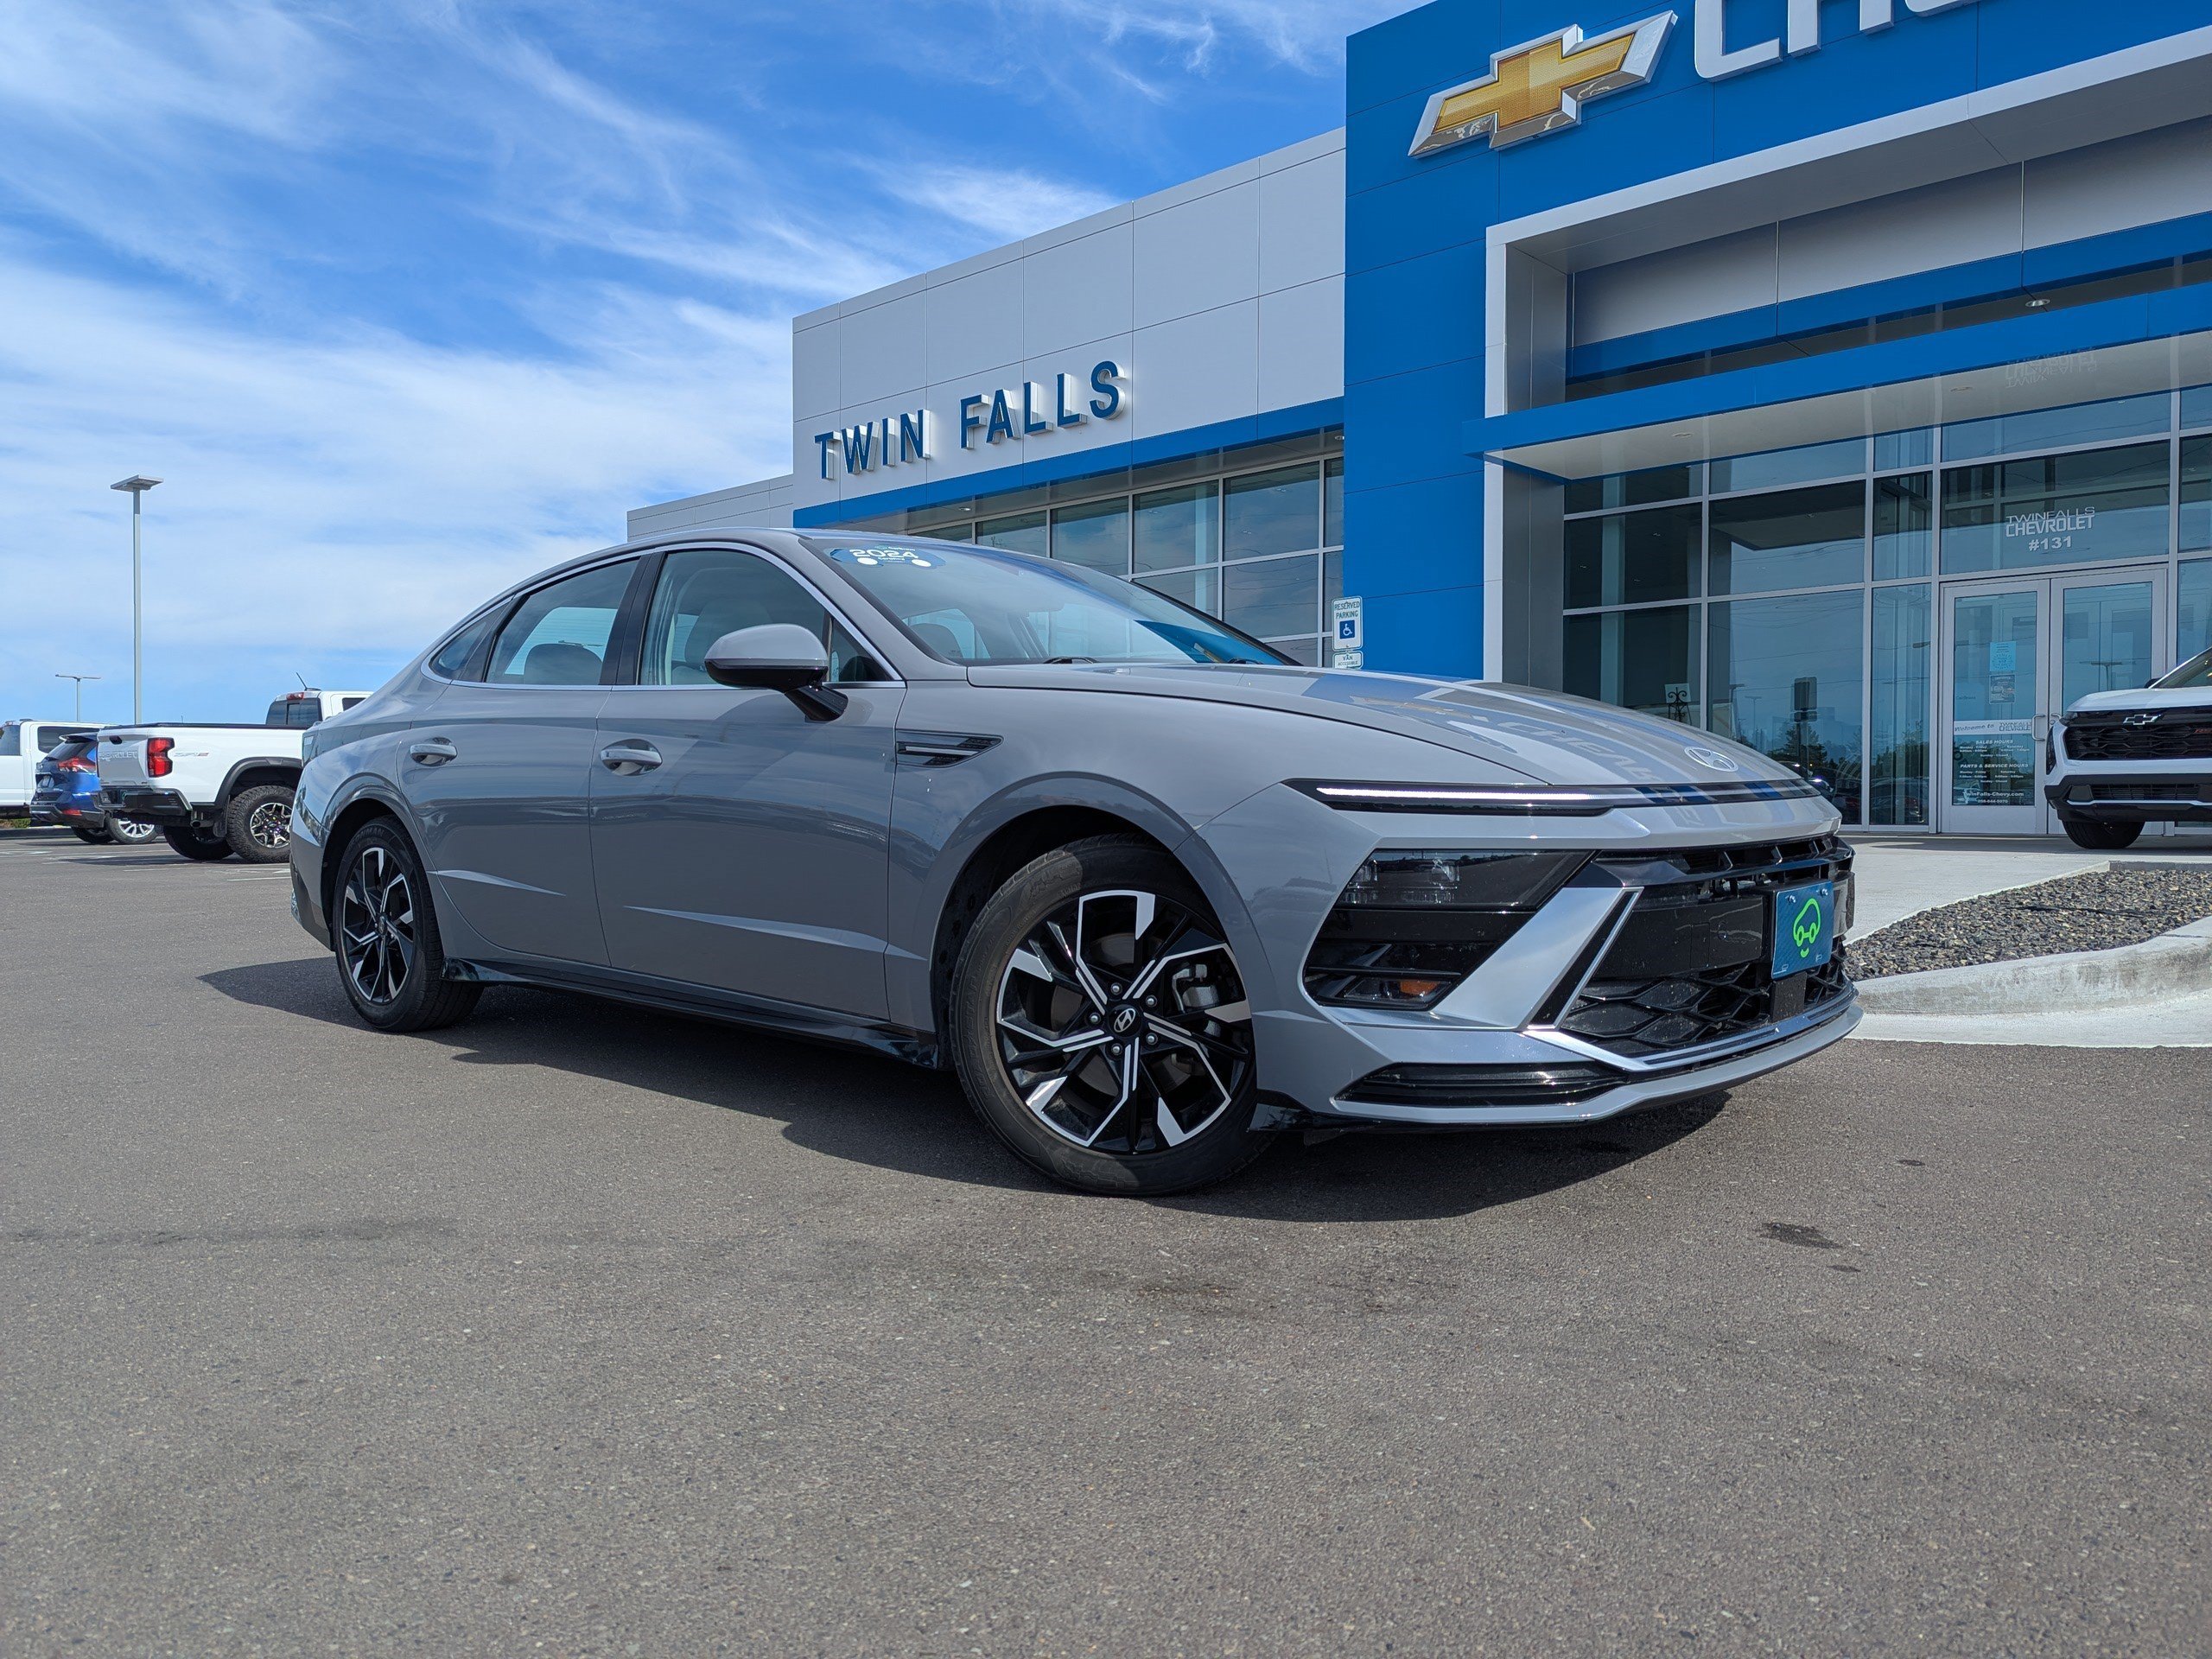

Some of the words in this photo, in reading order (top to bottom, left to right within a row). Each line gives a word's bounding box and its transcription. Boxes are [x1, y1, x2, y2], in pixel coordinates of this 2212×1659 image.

[815, 410, 931, 480] TWIN
[960, 360, 1126, 449] FALLS
[2005, 506, 2095, 524] TWINFALLS
[2005, 514, 2095, 537] CHEVROLET
[2028, 536, 2072, 551] #131
[849, 549, 919, 559] 2024
[1335, 601, 1360, 610] RESERVED
[1336, 610, 1358, 619] PARKING
[1955, 724, 1986, 733] Welcome
